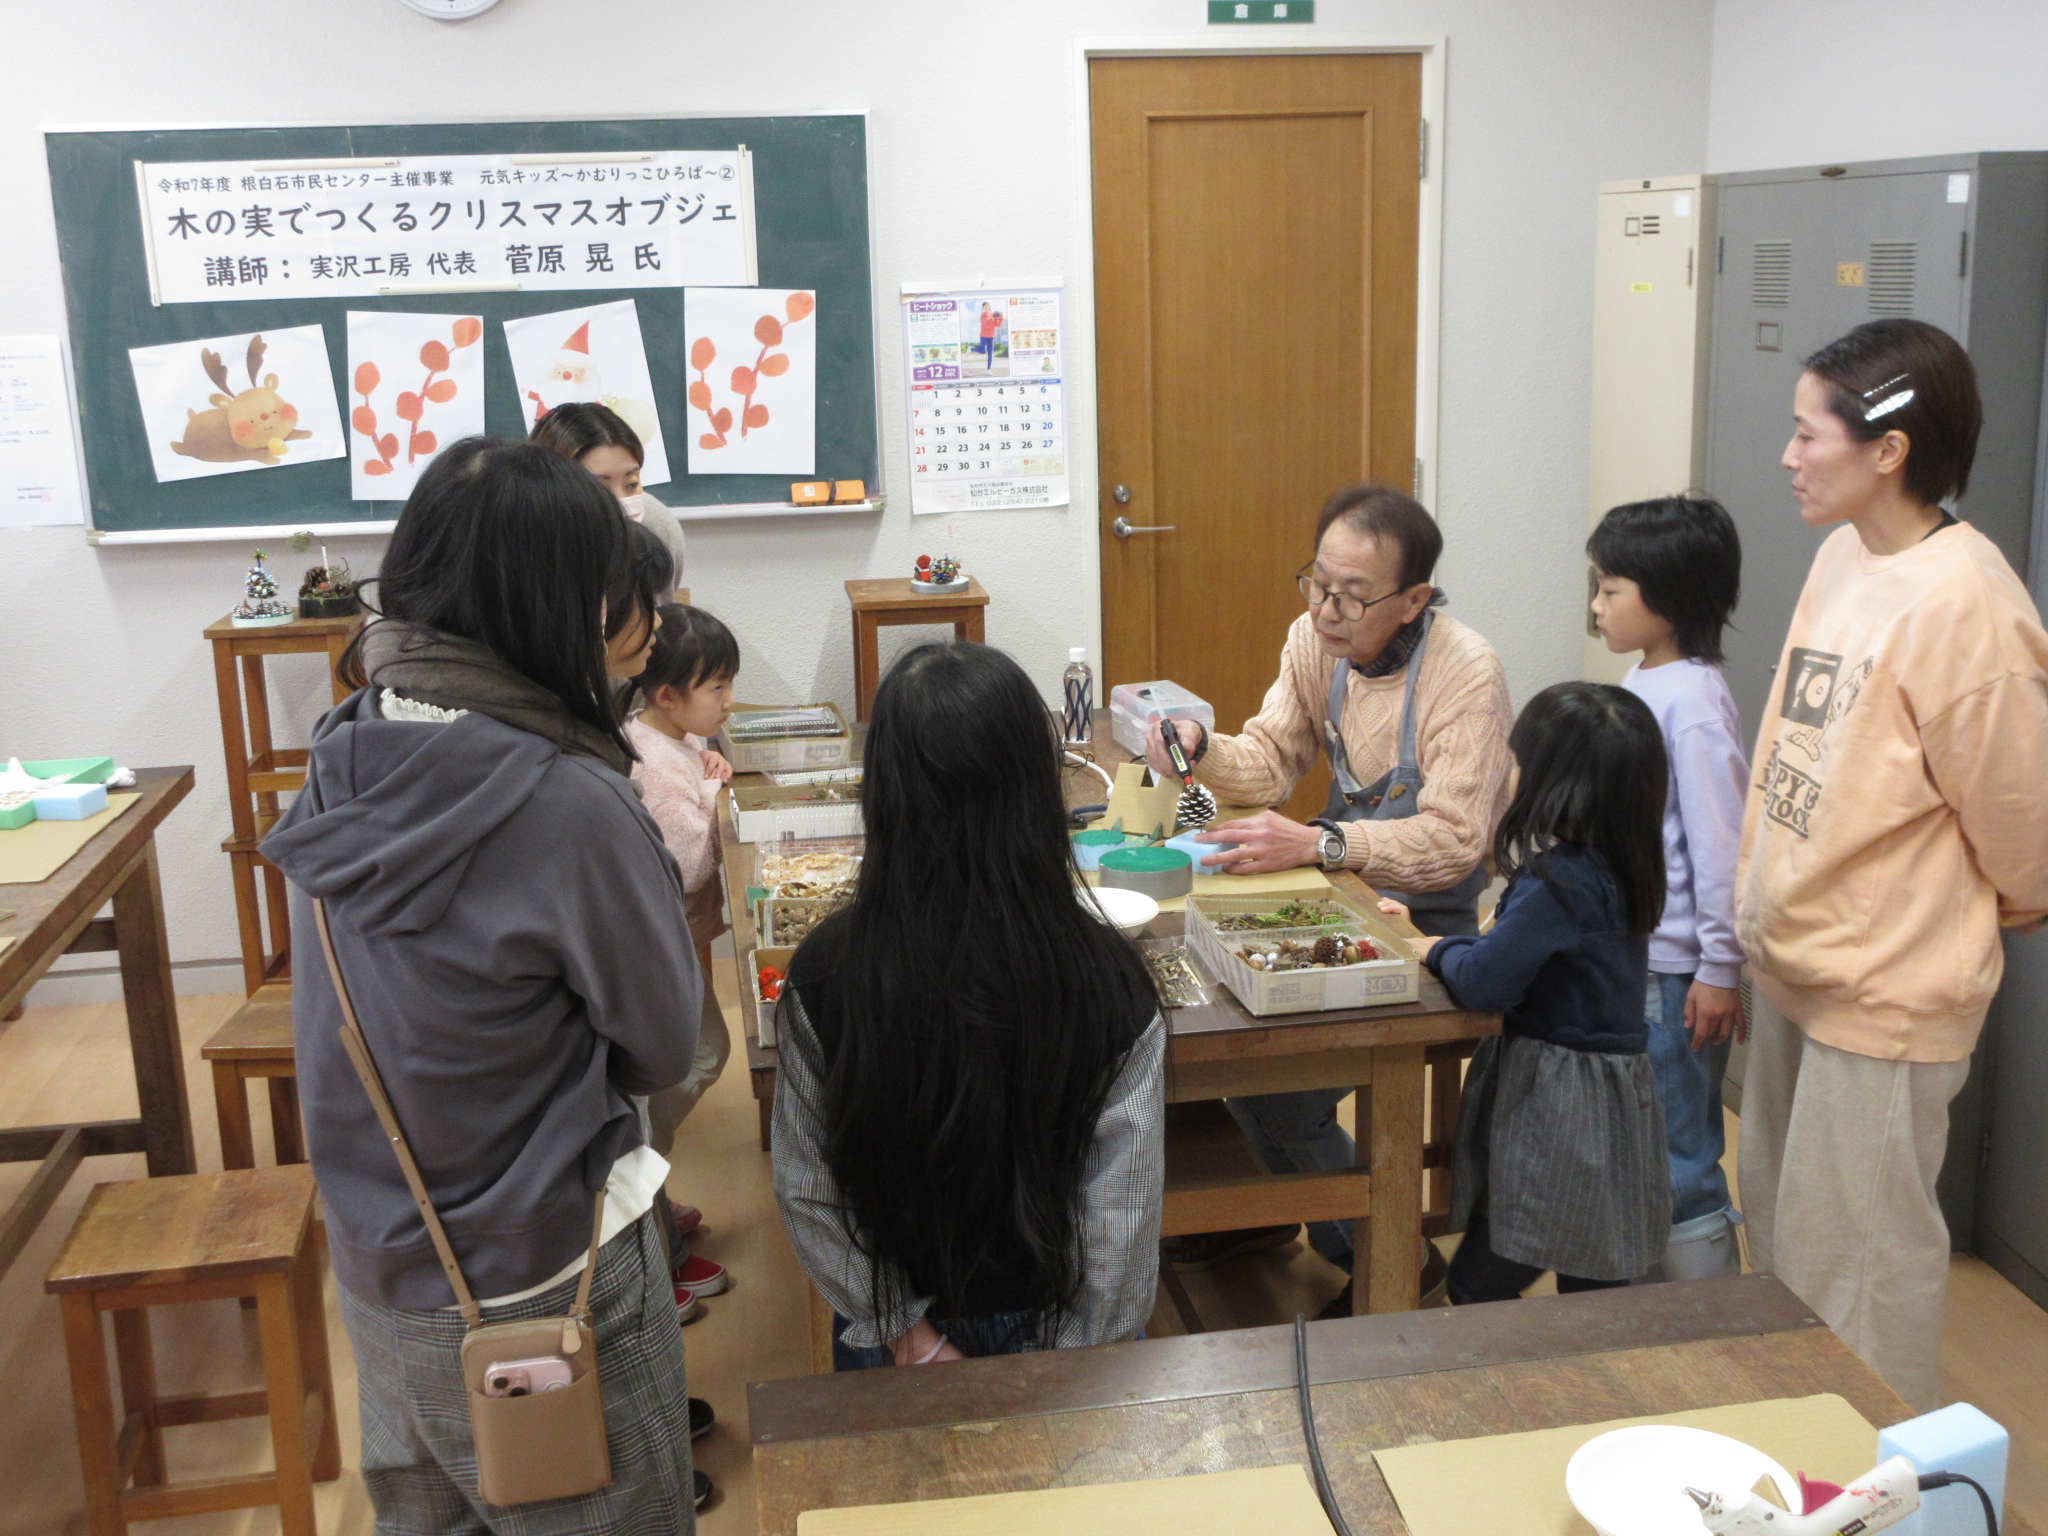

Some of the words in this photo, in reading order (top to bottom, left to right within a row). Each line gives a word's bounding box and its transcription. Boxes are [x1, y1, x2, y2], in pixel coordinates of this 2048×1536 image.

[158, 176, 231, 194] 令和7年度
[241, 171, 455, 190] 根白石市民センター主催事業
[168, 192, 737, 240] 木の実でつくるクリスマスオブジェ
[427, 251, 478, 276] 代表
[505, 244, 566, 274] 菅原
[585, 243, 614, 273] 晃
[634, 242, 662, 272] 氏
[913, 302, 953, 311] ヒートショック
[928, 366, 943, 378] 12
[935, 409, 940, 417] 8
[937, 445, 947, 453] 22
[958, 444, 968, 452] 23
[980, 443, 990, 451] 24
[1001, 442, 1011, 450] 25
[938, 463, 948, 471] 29
[959, 462, 969, 470] 30
[980, 461, 990, 469] 31
